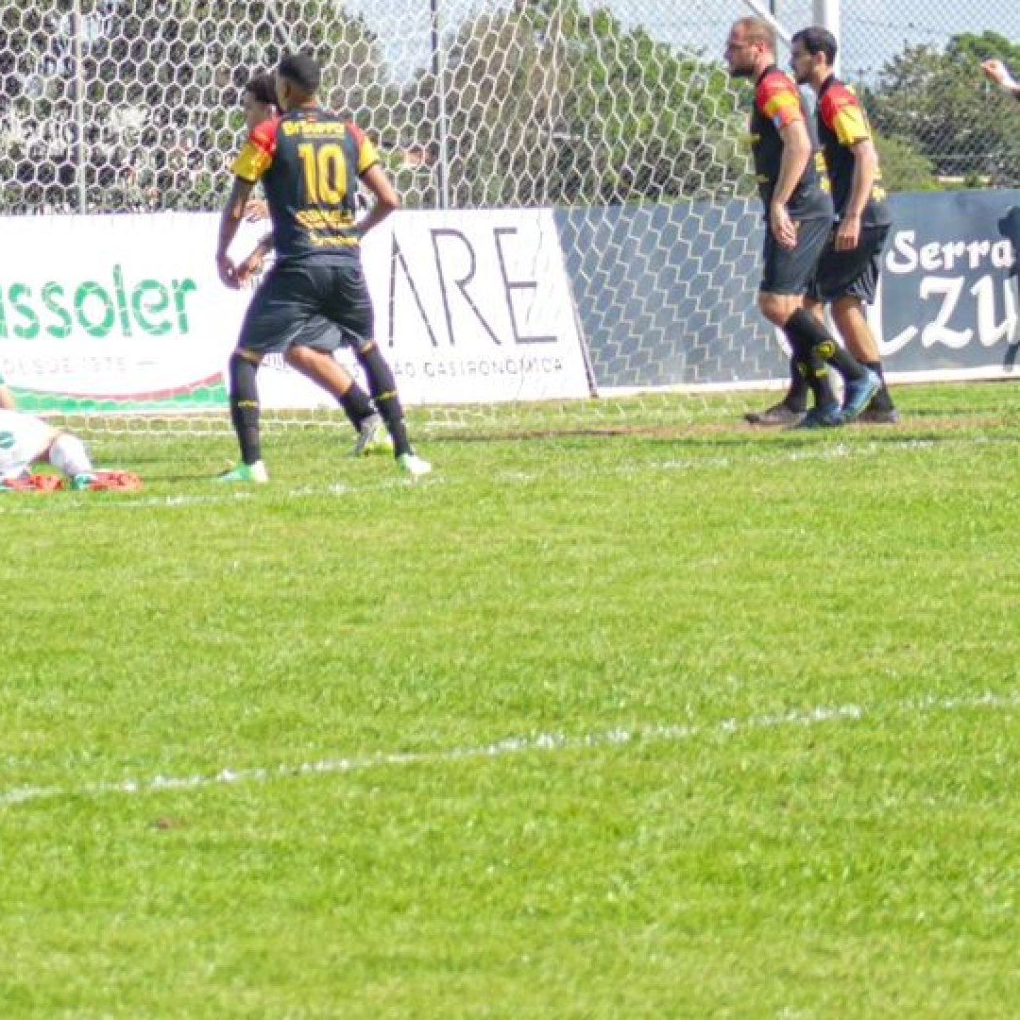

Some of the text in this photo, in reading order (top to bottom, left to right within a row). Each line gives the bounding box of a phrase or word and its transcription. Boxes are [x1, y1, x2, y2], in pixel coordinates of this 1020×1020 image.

[297, 142, 347, 205] 10
[886, 230, 1015, 273] Serra
[388, 228, 557, 348] ARE
